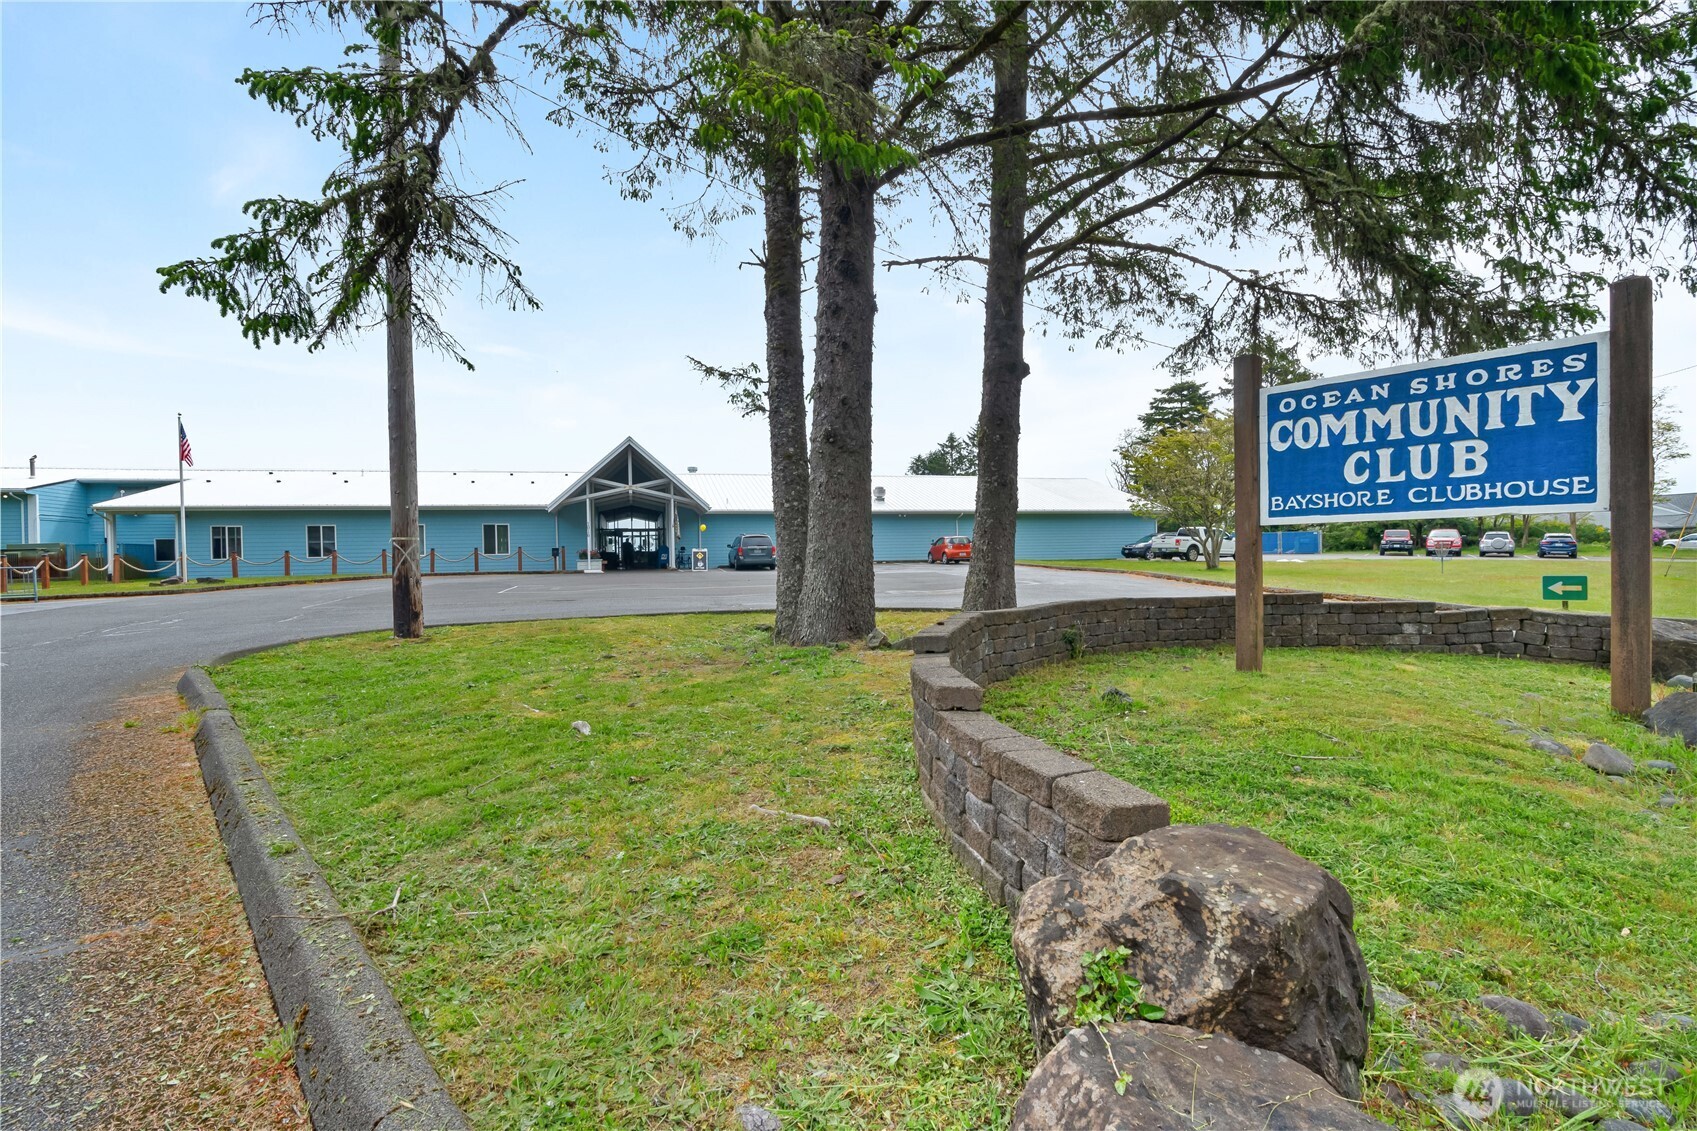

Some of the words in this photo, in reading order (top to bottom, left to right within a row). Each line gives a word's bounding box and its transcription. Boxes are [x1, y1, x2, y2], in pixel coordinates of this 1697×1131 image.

[1279, 382, 1390, 414] OCEAN
[1410, 352, 1588, 395] SHORES
[1269, 377, 1597, 452] COMMUNITY
[1343, 438, 1490, 485] CLUB
[1270, 489, 1394, 511] BAYSHORE
[1407, 475, 1596, 504] CLUBHOUSE
